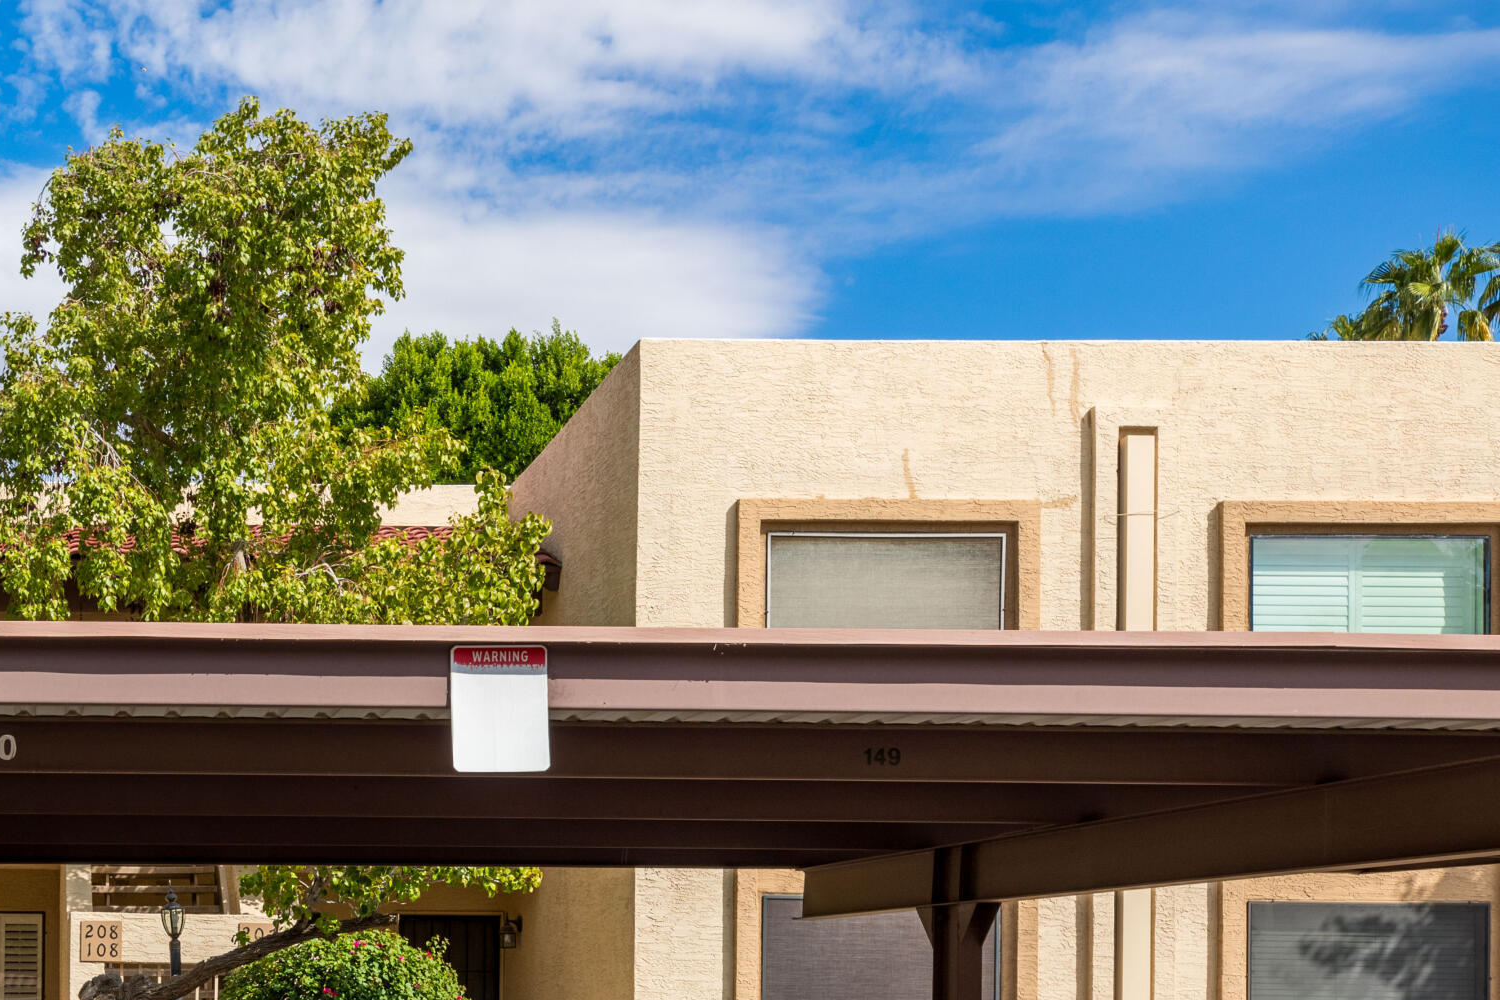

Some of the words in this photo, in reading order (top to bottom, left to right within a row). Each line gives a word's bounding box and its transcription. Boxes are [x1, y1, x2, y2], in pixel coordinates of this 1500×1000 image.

[472, 650, 529, 663] WARNING
[863, 747, 901, 766] 149
[85, 924, 118, 940] 208
[86, 942, 118, 958] 108
